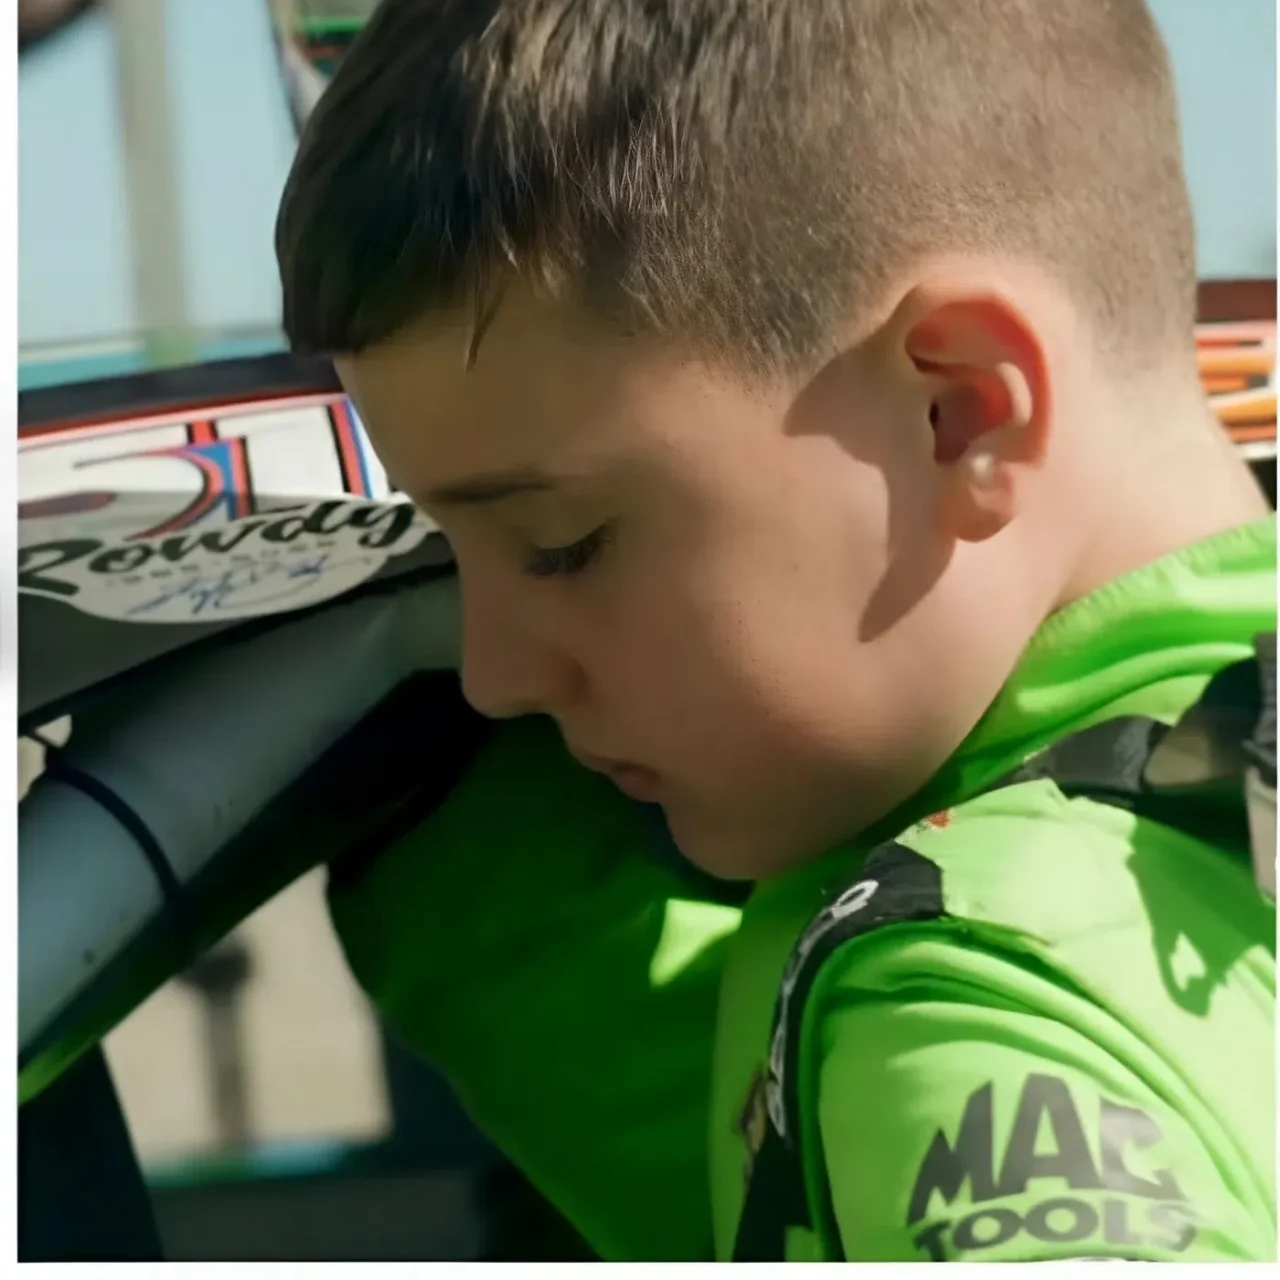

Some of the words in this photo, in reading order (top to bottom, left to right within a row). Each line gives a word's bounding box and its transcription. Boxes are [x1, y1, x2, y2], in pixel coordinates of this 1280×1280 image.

[18, 499, 416, 596] Rowdy
[907, 1071, 1190, 1228] MAC
[913, 1197, 1197, 1262] TOOLS
